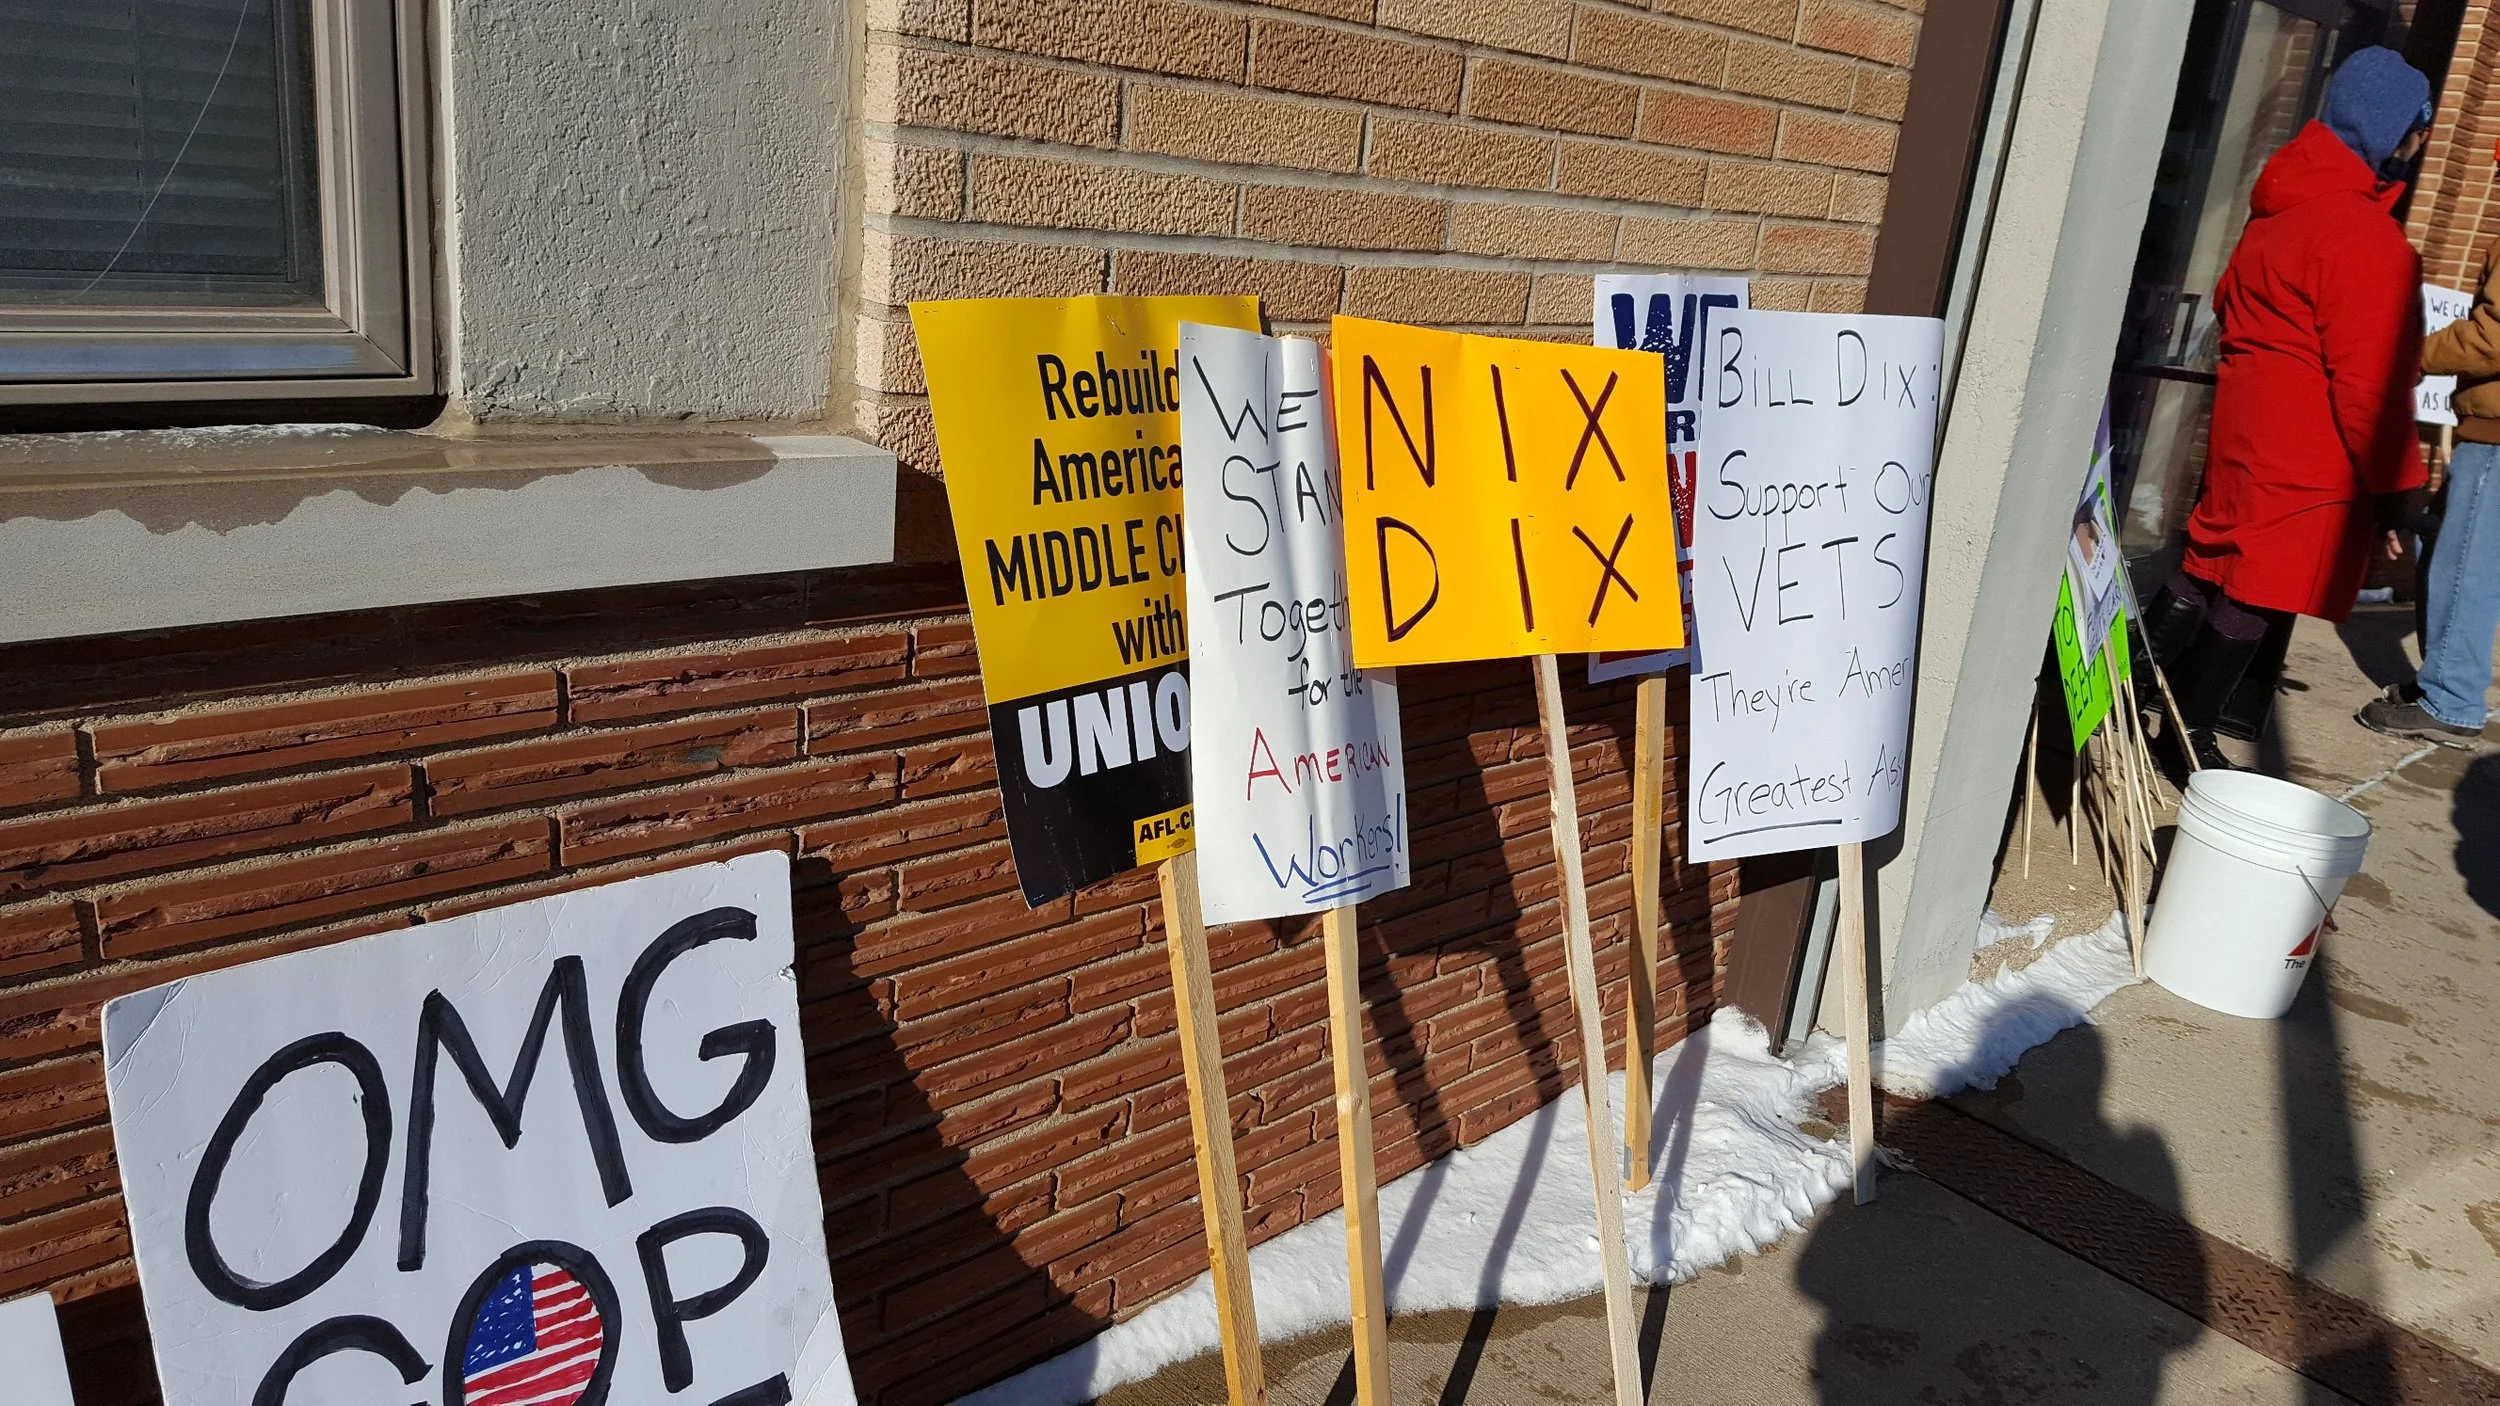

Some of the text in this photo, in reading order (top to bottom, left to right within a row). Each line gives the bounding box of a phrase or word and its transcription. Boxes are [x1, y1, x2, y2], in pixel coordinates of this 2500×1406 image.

[2431, 299, 2449, 318] WE
[1037, 350, 1181, 421] Rebuild
[1193, 351, 1319, 446] WE
[1363, 354, 1626, 491] NIX
[1032, 430, 1183, 506] America
[1707, 450, 1848, 548] Support
[1875, 461, 1931, 515] Our
[985, 519, 1149, 606] MIDDLE
[1376, 513, 1639, 642] DIX
[1722, 533, 1904, 632] VETS
[1112, 594, 1186, 666] with
[1288, 657, 1332, 711] for
[1701, 669, 1816, 733] They're
[1698, 760, 1853, 825] Greatest
[2284, 958, 2306, 969] The
[185, 905, 777, 1311] OMG
